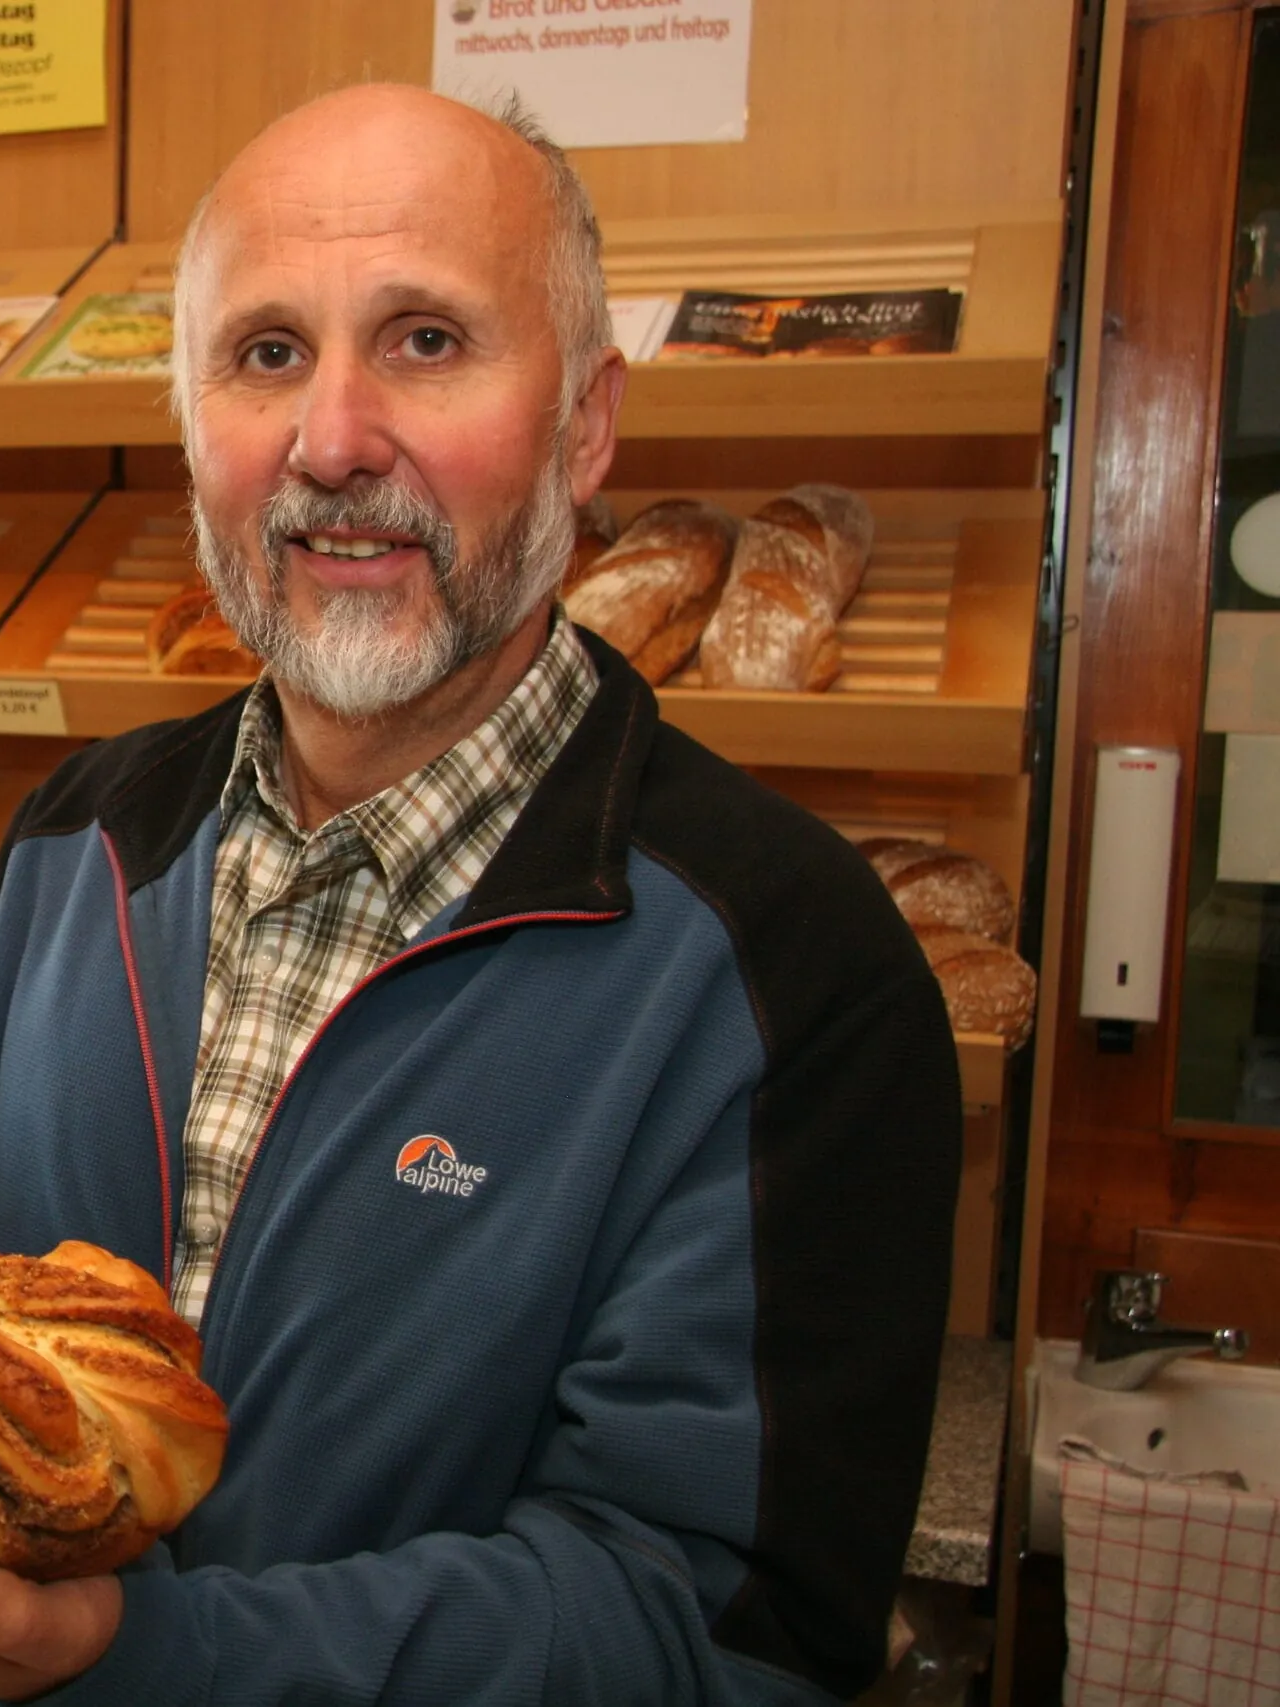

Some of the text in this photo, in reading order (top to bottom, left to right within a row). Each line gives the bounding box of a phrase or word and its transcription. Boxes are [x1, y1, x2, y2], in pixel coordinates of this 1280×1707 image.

[488, 0, 535, 19] Brot
[543, 0, 586, 14] und
[539, 23, 629, 49] donnerstags
[635, 15, 667, 42] und
[671, 13, 729, 43] freitags
[403, 1166, 474, 1197] alpine
[427, 1149, 487, 1182] Lowe
